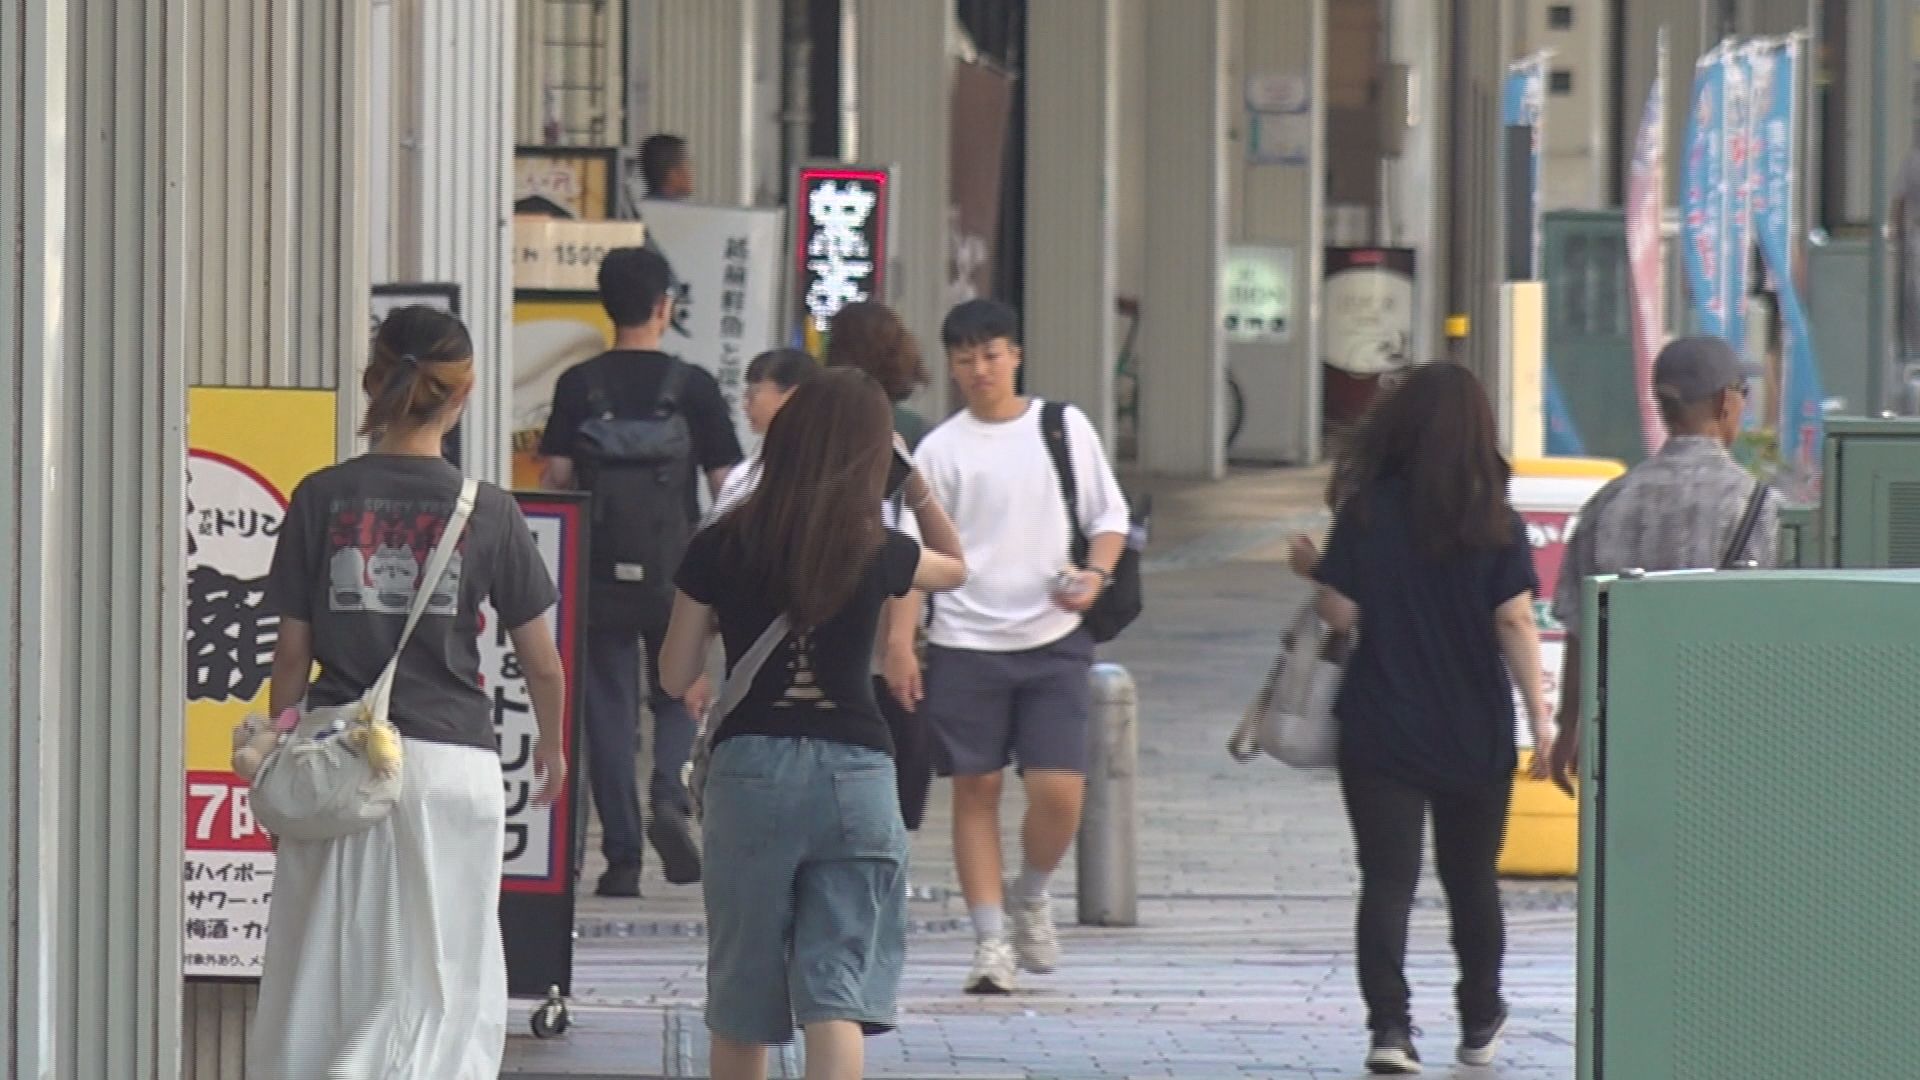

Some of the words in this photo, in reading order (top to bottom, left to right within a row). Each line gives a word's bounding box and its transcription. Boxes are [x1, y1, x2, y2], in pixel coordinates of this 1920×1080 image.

[186, 917, 268, 939] 梅酒・カ
[185, 953, 265, 967] 対象外あり、メ
